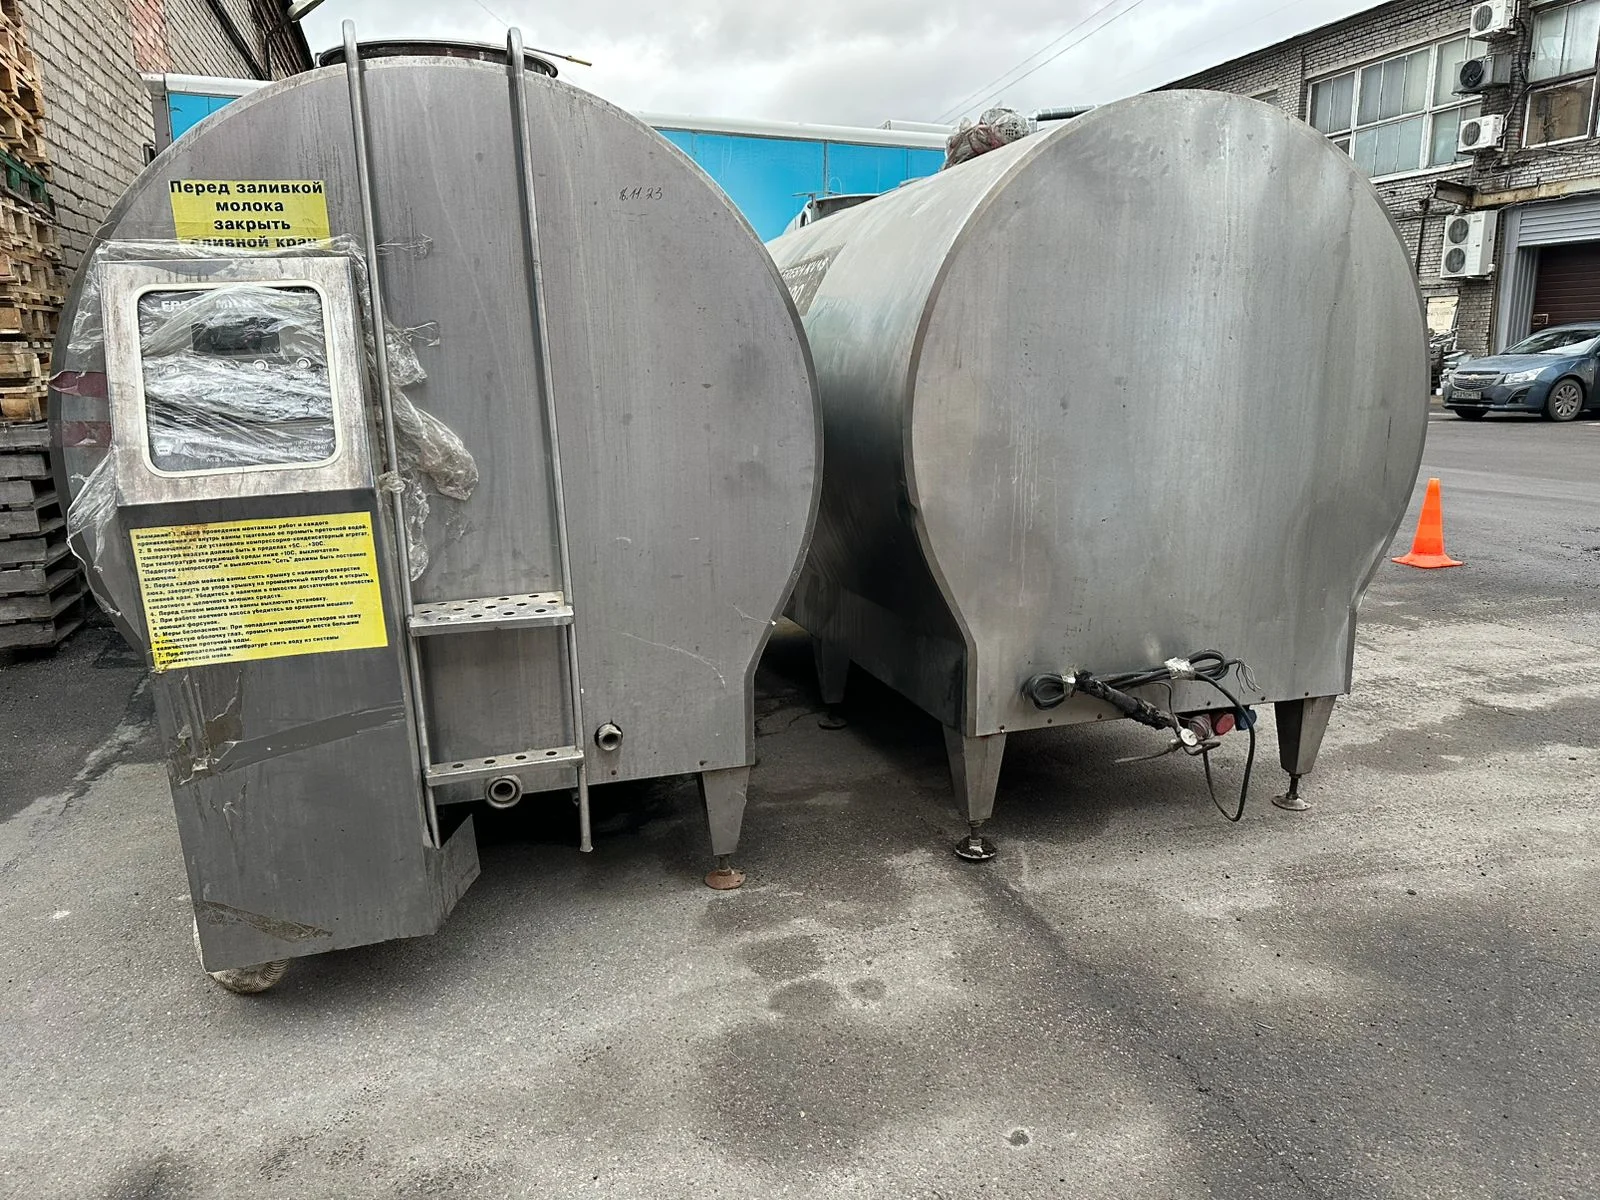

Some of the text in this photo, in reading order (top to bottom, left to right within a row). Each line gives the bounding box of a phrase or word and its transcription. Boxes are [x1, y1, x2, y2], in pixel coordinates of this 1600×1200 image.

[170, 181, 323, 196] Перед заливкой
[216, 201, 284, 212] молока
[214, 220, 291, 232] закрыть
